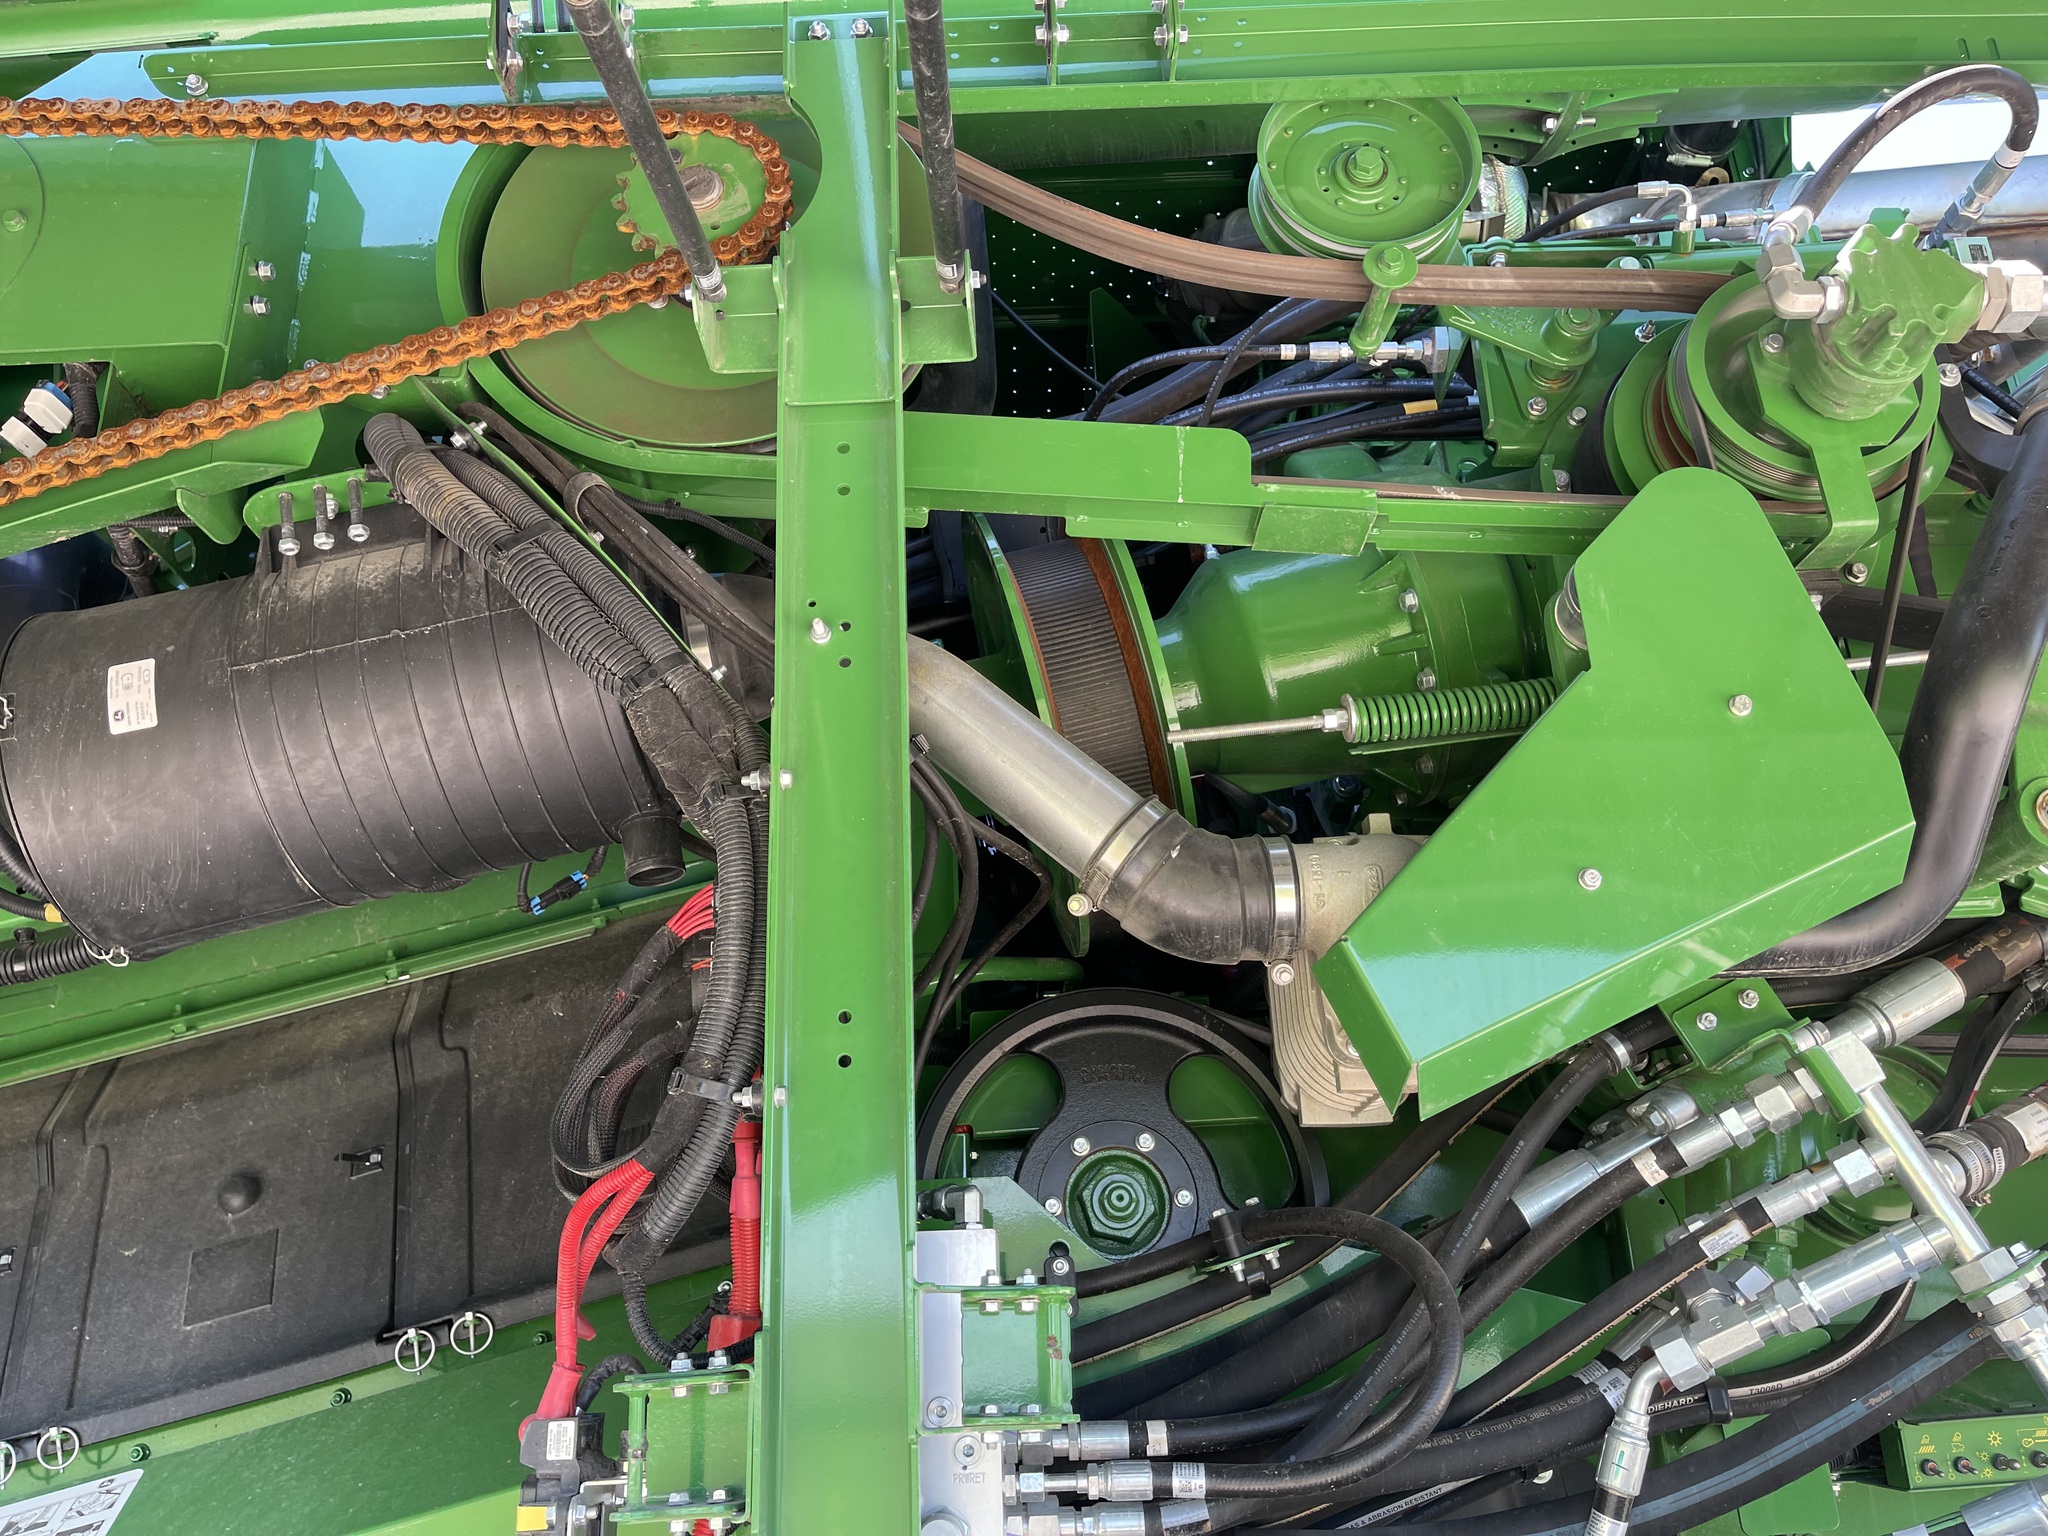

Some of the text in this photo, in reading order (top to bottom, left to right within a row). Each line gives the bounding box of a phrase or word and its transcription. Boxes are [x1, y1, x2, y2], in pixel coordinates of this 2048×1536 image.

[1490, 1421, 1512, 1433] mm)
[1511, 1414, 1527, 1426] ISO
[1529, 1407, 1550, 1421] 3862
[1550, 1401, 1567, 1414] R15
[1567, 1393, 1585, 1405] 4SH
[1367, 1504, 1404, 1523] ABRASION
[1404, 1487, 1443, 1507] RESISTANT
